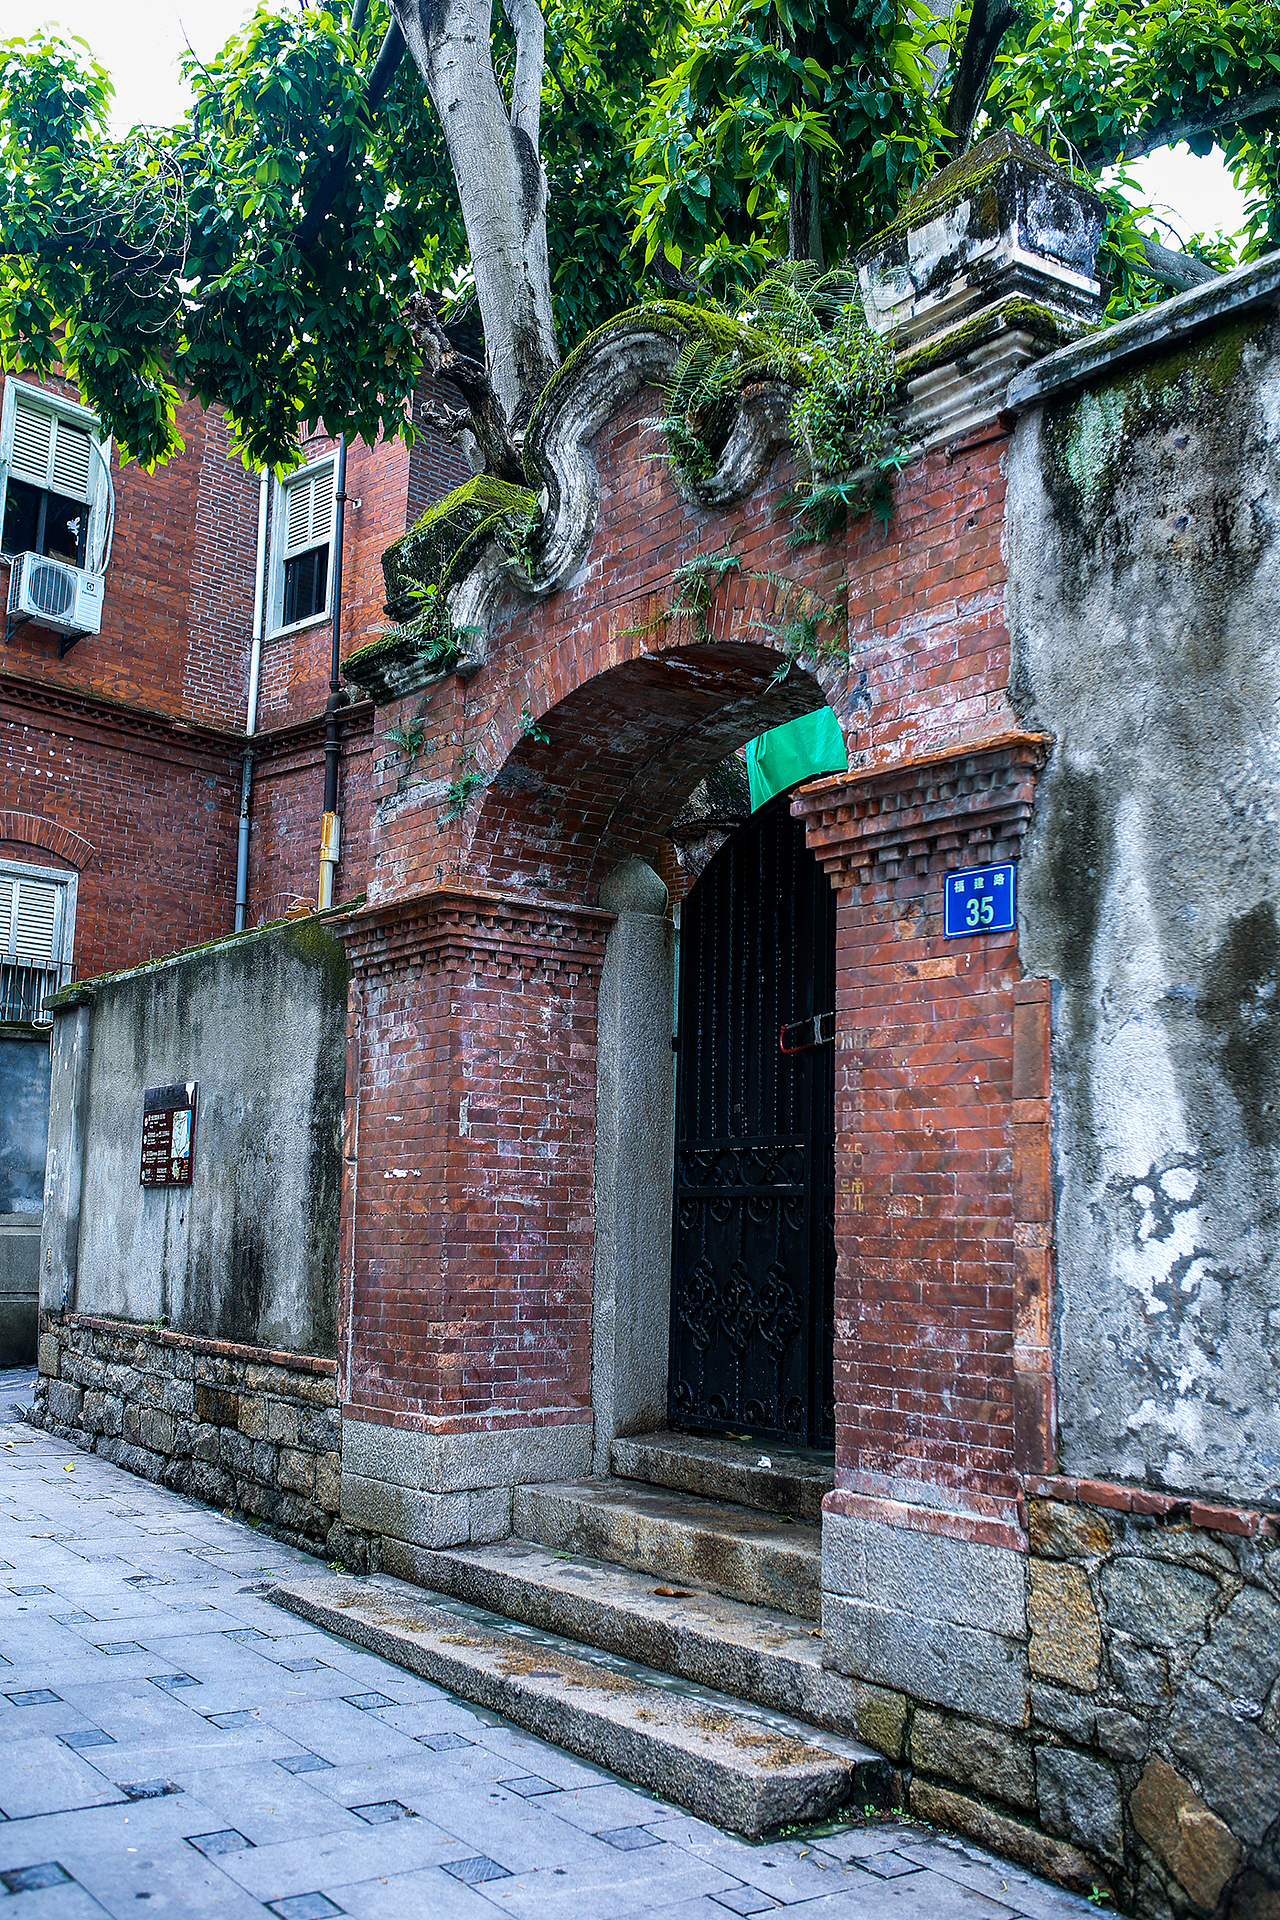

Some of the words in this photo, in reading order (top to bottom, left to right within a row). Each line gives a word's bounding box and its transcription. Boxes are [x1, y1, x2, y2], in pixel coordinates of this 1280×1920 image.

[953, 872, 1005, 894] 福建路
[965, 895, 994, 927] 35
